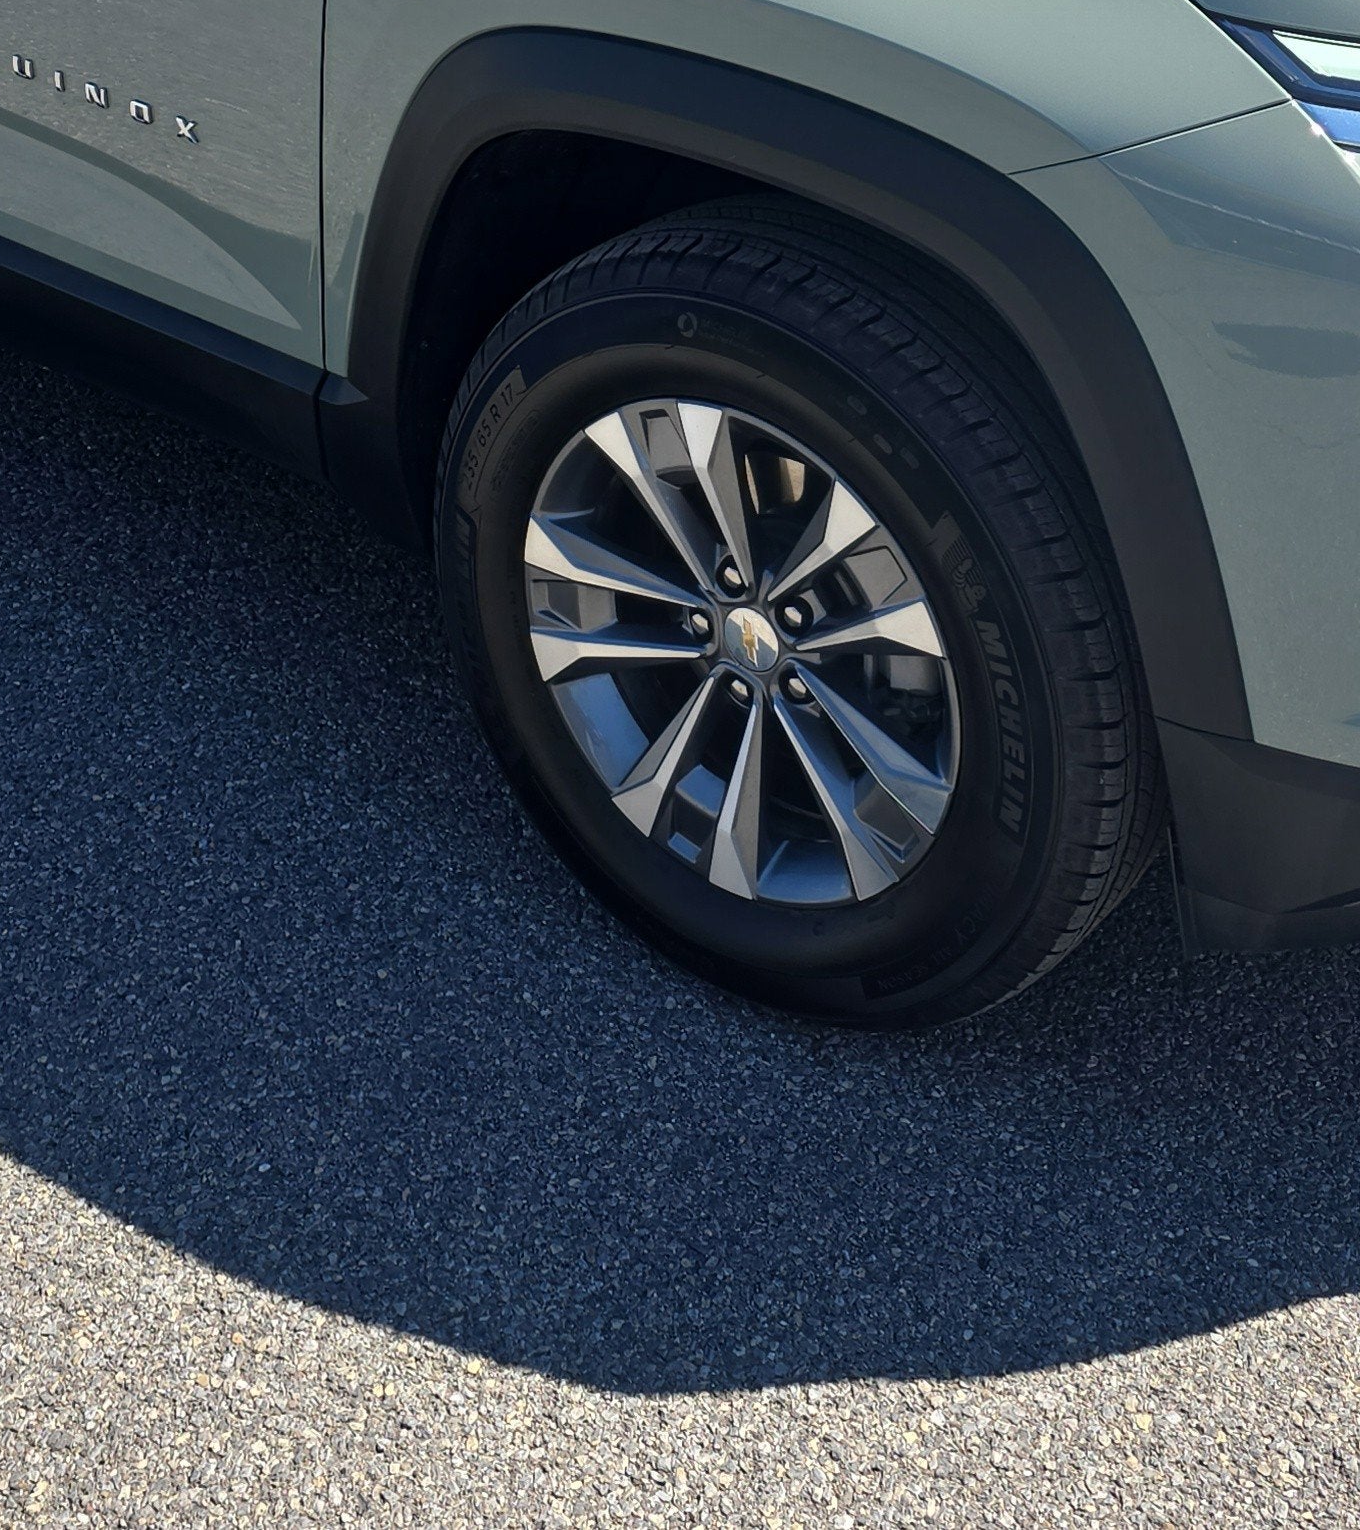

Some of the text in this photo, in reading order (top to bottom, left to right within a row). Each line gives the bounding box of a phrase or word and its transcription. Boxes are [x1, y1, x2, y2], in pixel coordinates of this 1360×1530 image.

[489, 403, 502, 424] R
[501, 382, 515, 406] 17
[977, 619, 1027, 834] MICHELIN
